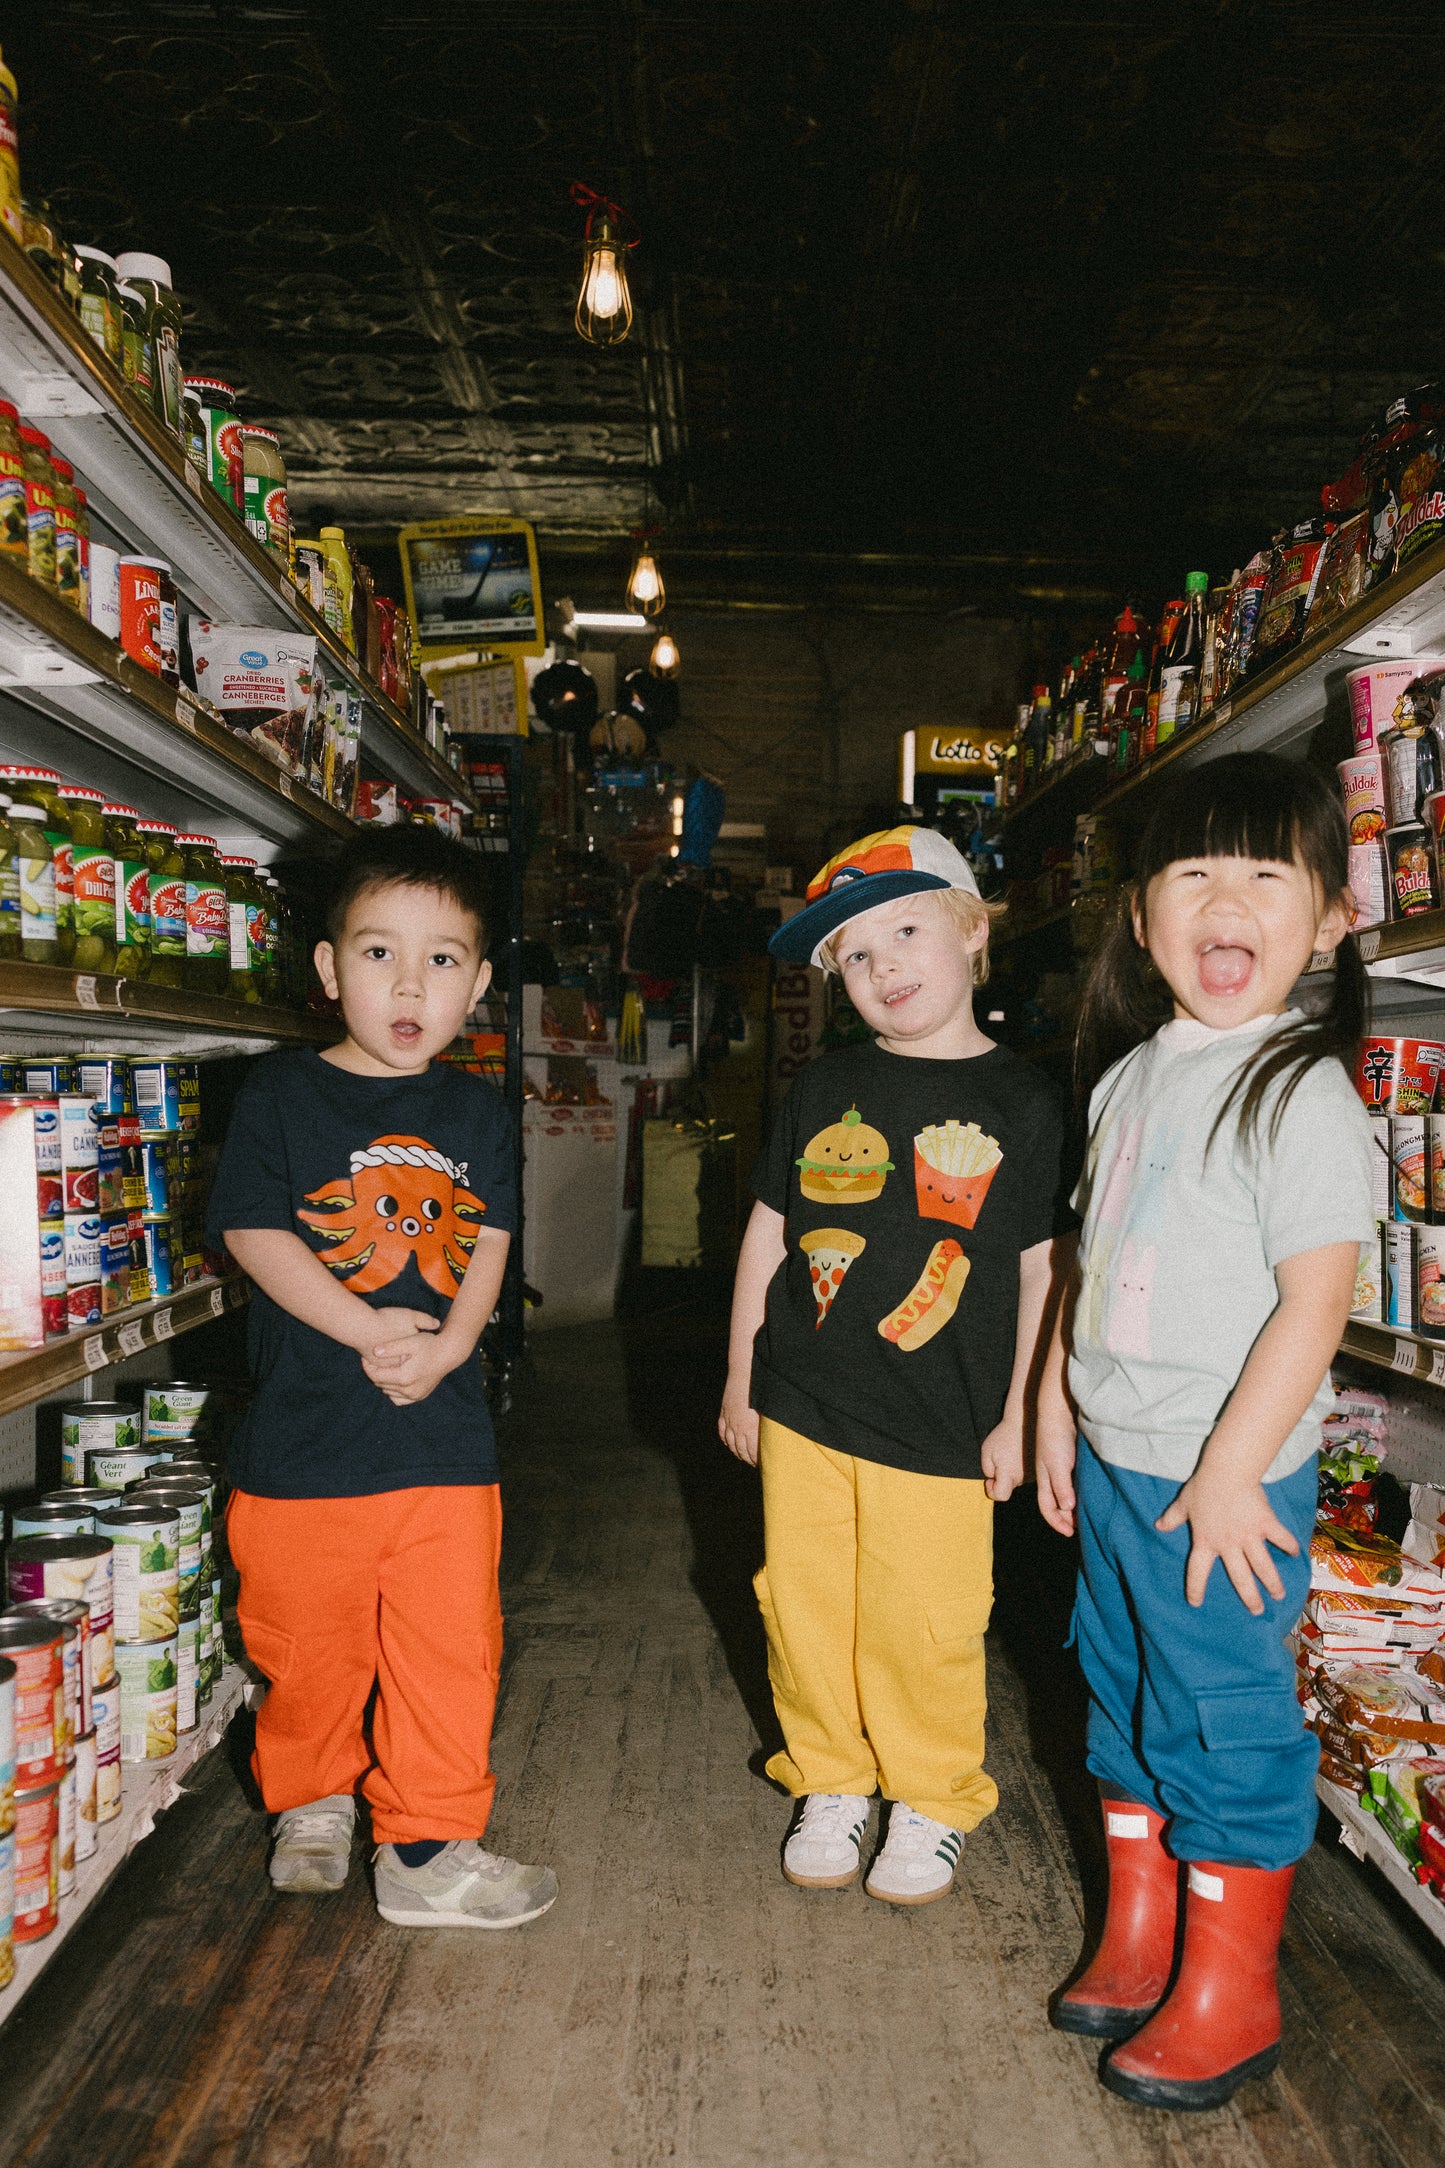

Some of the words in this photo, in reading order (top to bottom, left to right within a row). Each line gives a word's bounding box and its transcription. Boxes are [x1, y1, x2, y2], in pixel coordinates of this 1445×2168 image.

[242, 653, 264, 662] Great
[1384, 670, 1413, 678] Samyang
[223, 675, 285, 686] CRANBERRIES
[222, 692, 286, 703] CANNEBERGES
[931, 737, 981, 763] Lotto
[1343, 775, 1378, 801] Buldak
[85, 881, 102, 896] Dill
[164, 903, 186, 918] Baby
[195, 911, 220, 926] Baby
[1363, 1046, 1405, 1101] 辛
[179, 1079, 200, 1097] SPAM
[1396, 1087, 1420, 1096] SHIN
[172, 1400, 192, 1408] Giant
[100, 1460, 126, 1470] Géant
[104, 1470, 123, 1478] Vert
